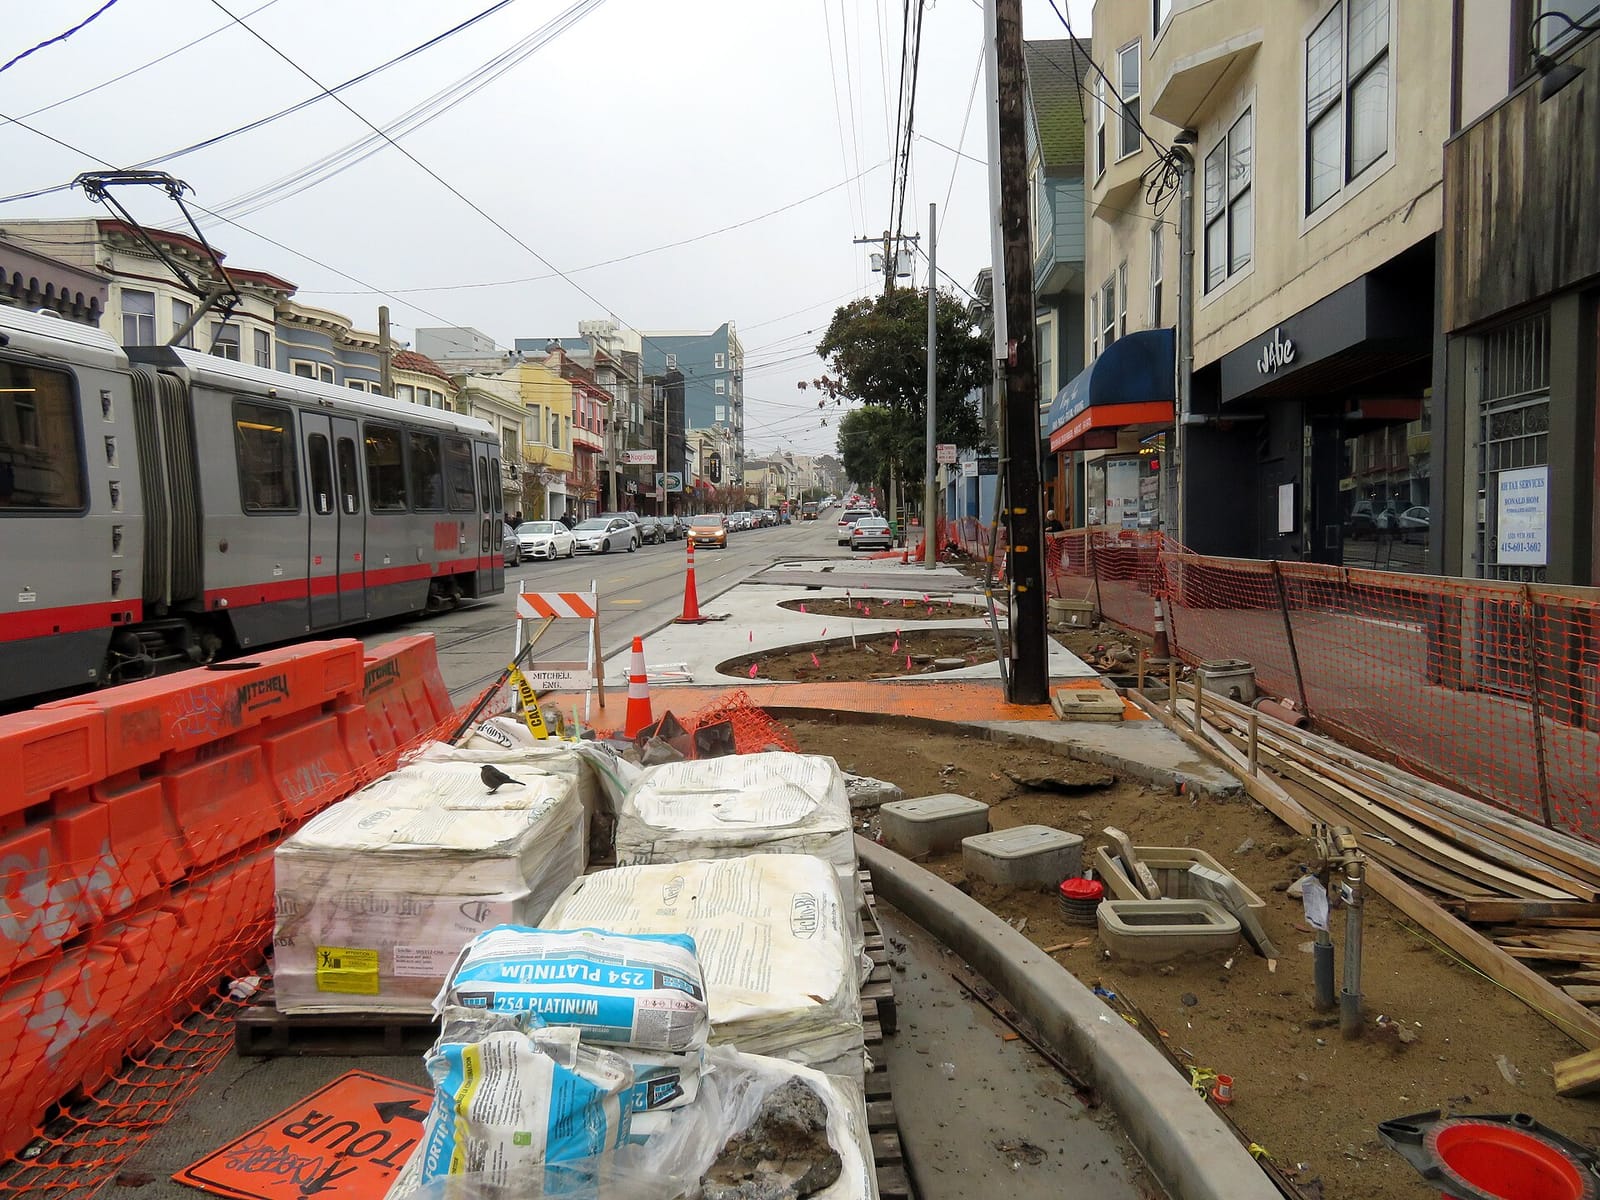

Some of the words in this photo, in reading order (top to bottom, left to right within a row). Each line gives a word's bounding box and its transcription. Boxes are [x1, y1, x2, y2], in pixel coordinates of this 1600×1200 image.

[1519, 478, 1545, 489] SERVICES
[1504, 497, 1525, 506] RONALD
[1501, 542, 1542, 553] 415-601-3602
[533, 672, 572, 680] MITCHELL
[236, 673, 290, 706] MITCHELL
[501, 962, 601, 982] PLATINUM
[608, 970, 645, 986] 254
[499, 996, 524, 1011] 254
[529, 997, 598, 1016] PLATINUM
[282, 1109, 417, 1169] TOUR
